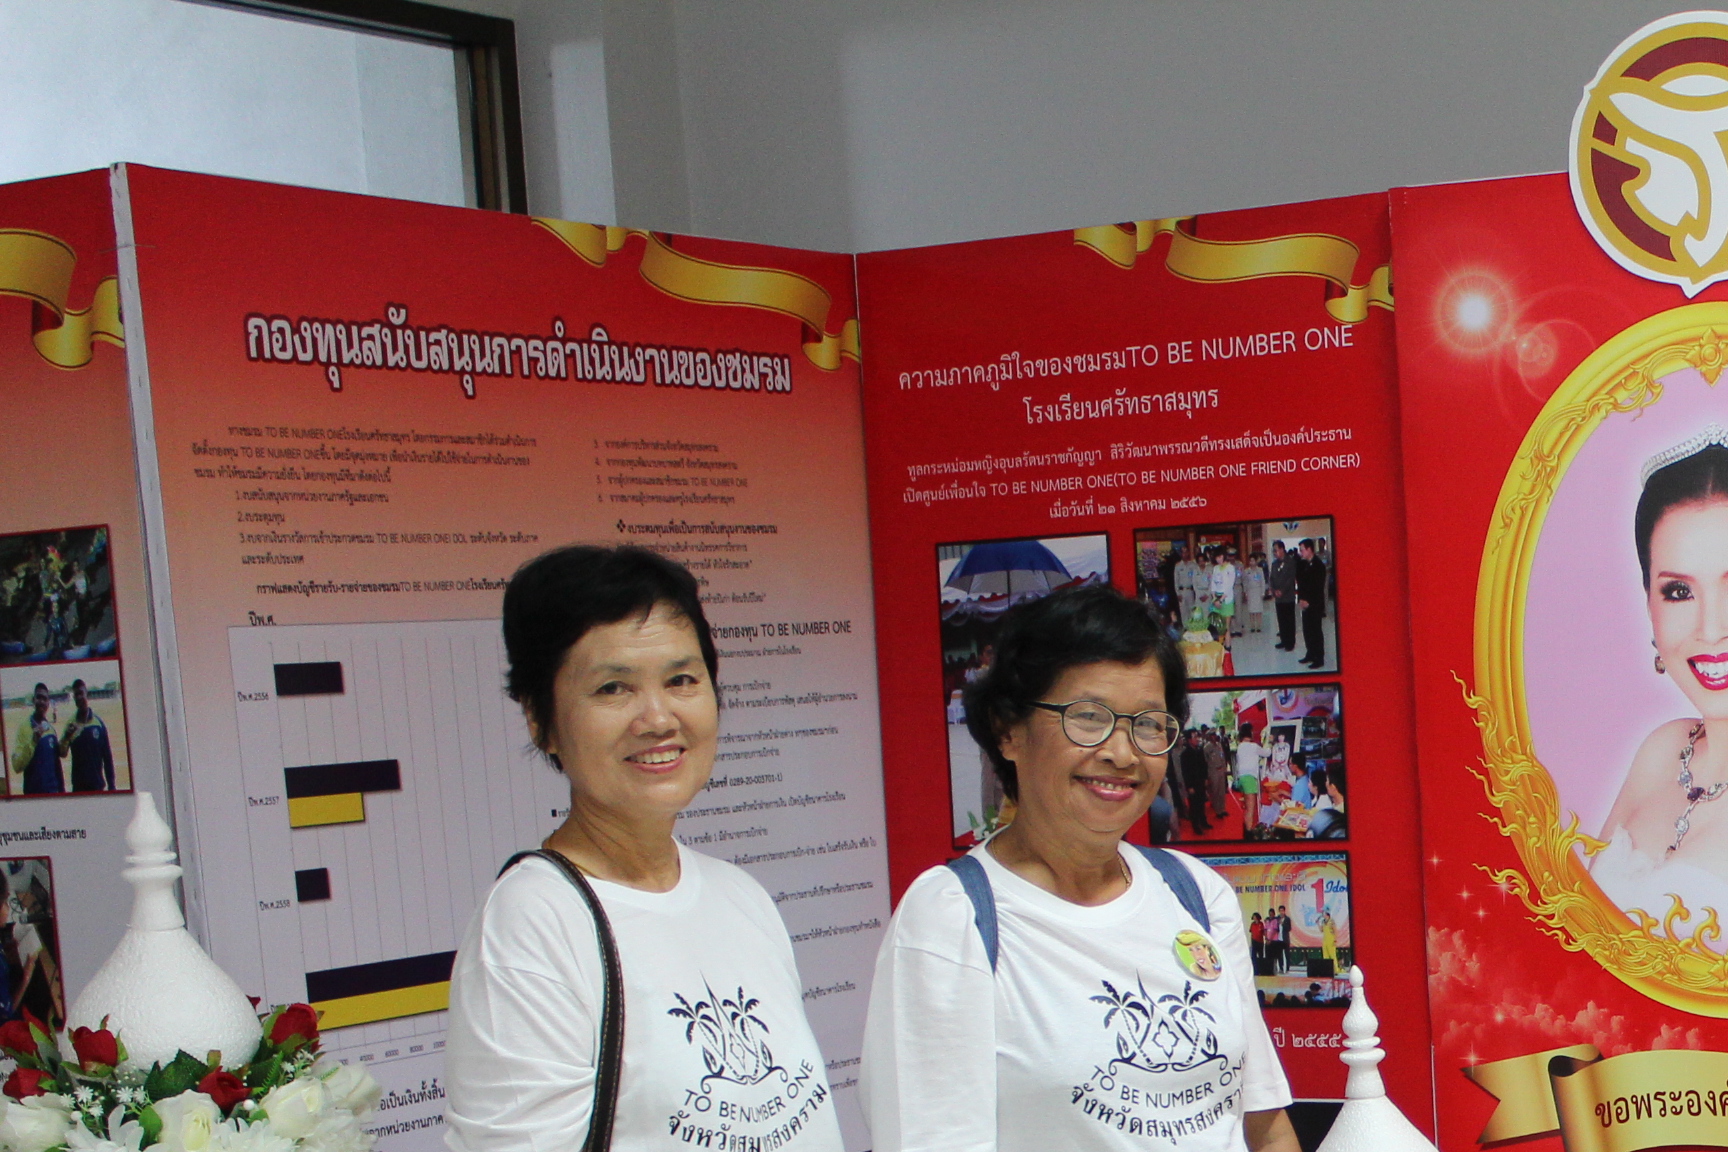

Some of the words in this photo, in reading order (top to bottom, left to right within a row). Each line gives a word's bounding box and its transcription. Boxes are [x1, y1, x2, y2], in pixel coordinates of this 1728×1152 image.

[246, 305, 793, 398] กองทุนสนับสนุนการดำเนินงานของชมรม
[1166, 339, 1194, 366] BE
[1201, 332, 1297, 362] NUMBER
[1303, 324, 1355, 352] ONE
[1022, 386, 1220, 427] โรงเรียนศรัทธาสมุทร
[268, 448, 302, 460] NUMBER
[291, 428, 325, 439] NUMBER
[989, 481, 1009, 498] TO
[1011, 480, 1028, 496] BE
[1030, 475, 1084, 495] NUMBER
[1141, 470, 1158, 486] BE
[1160, 464, 1216, 485] NUMBER
[1218, 461, 1248, 480] ONE
[1251, 457, 1298, 477] FRIEND
[1300, 451, 1362, 474] CORNER)
[1049, 498, 1095, 520] เมื่อวันที่
[1119, 495, 1168, 516] สิงหาคม
[760, 623, 775, 638] TO
[778, 622, 790, 636] BE
[792, 621, 830, 635] NUMBER
[832, 620, 852, 634] ONE
[1273, 1026, 1286, 1048] ปี
[1292, 1032, 1342, 1048] ๒๕๕๕
[684, 1088, 712, 1113] TO
[718, 1100, 737, 1121] BE
[739, 1095, 787, 1124] NUMBER
[786, 1058, 815, 1100] ONE
[1090, 1064, 1116, 1092] TO
[1119, 1084, 1140, 1106] BE
[1145, 1081, 1215, 1109] NUMBER
[1070, 1081, 1245, 1146] จังหวัดสมุทรสงครา
